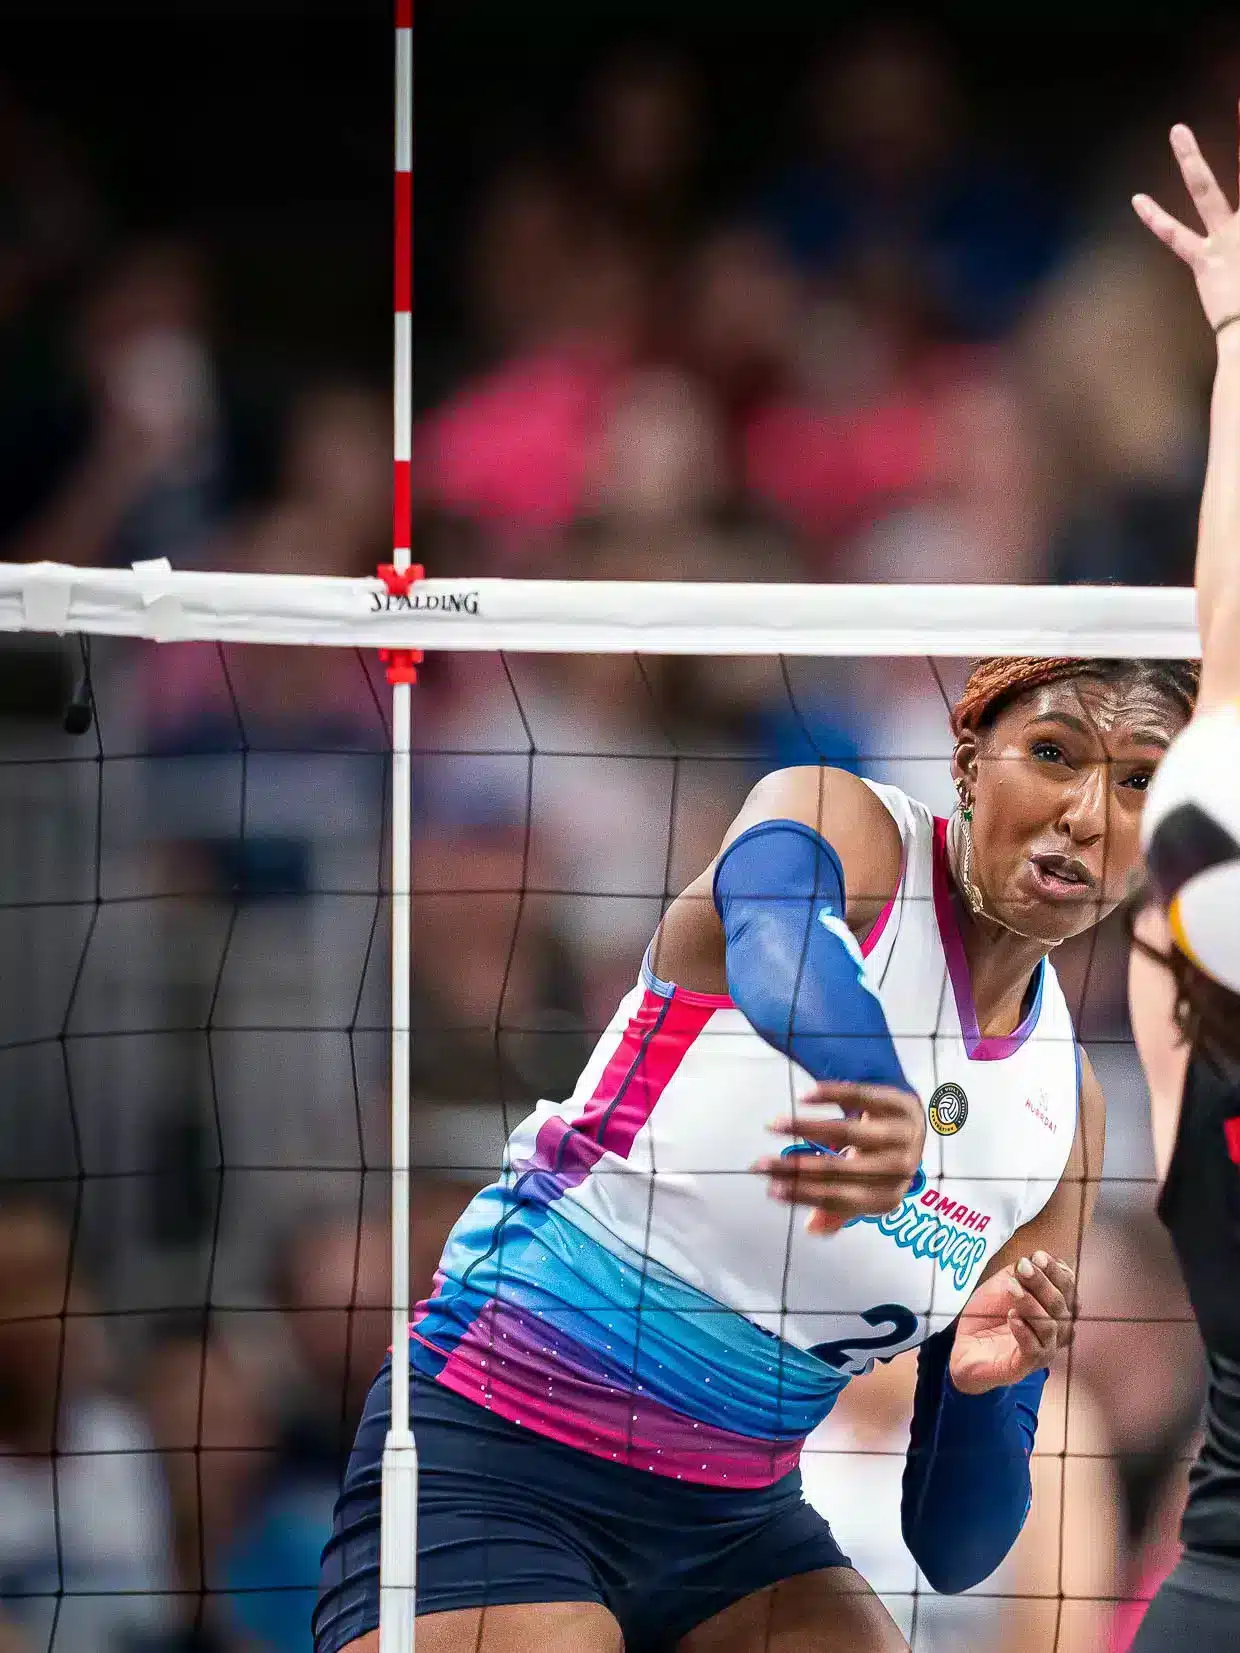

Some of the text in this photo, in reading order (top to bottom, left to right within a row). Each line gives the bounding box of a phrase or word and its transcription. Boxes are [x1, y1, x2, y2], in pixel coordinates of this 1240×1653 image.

[843, 1200, 987, 1291] ernovas
[920, 1189, 991, 1233] OMAHA
[803, 1303, 919, 1372] 2
